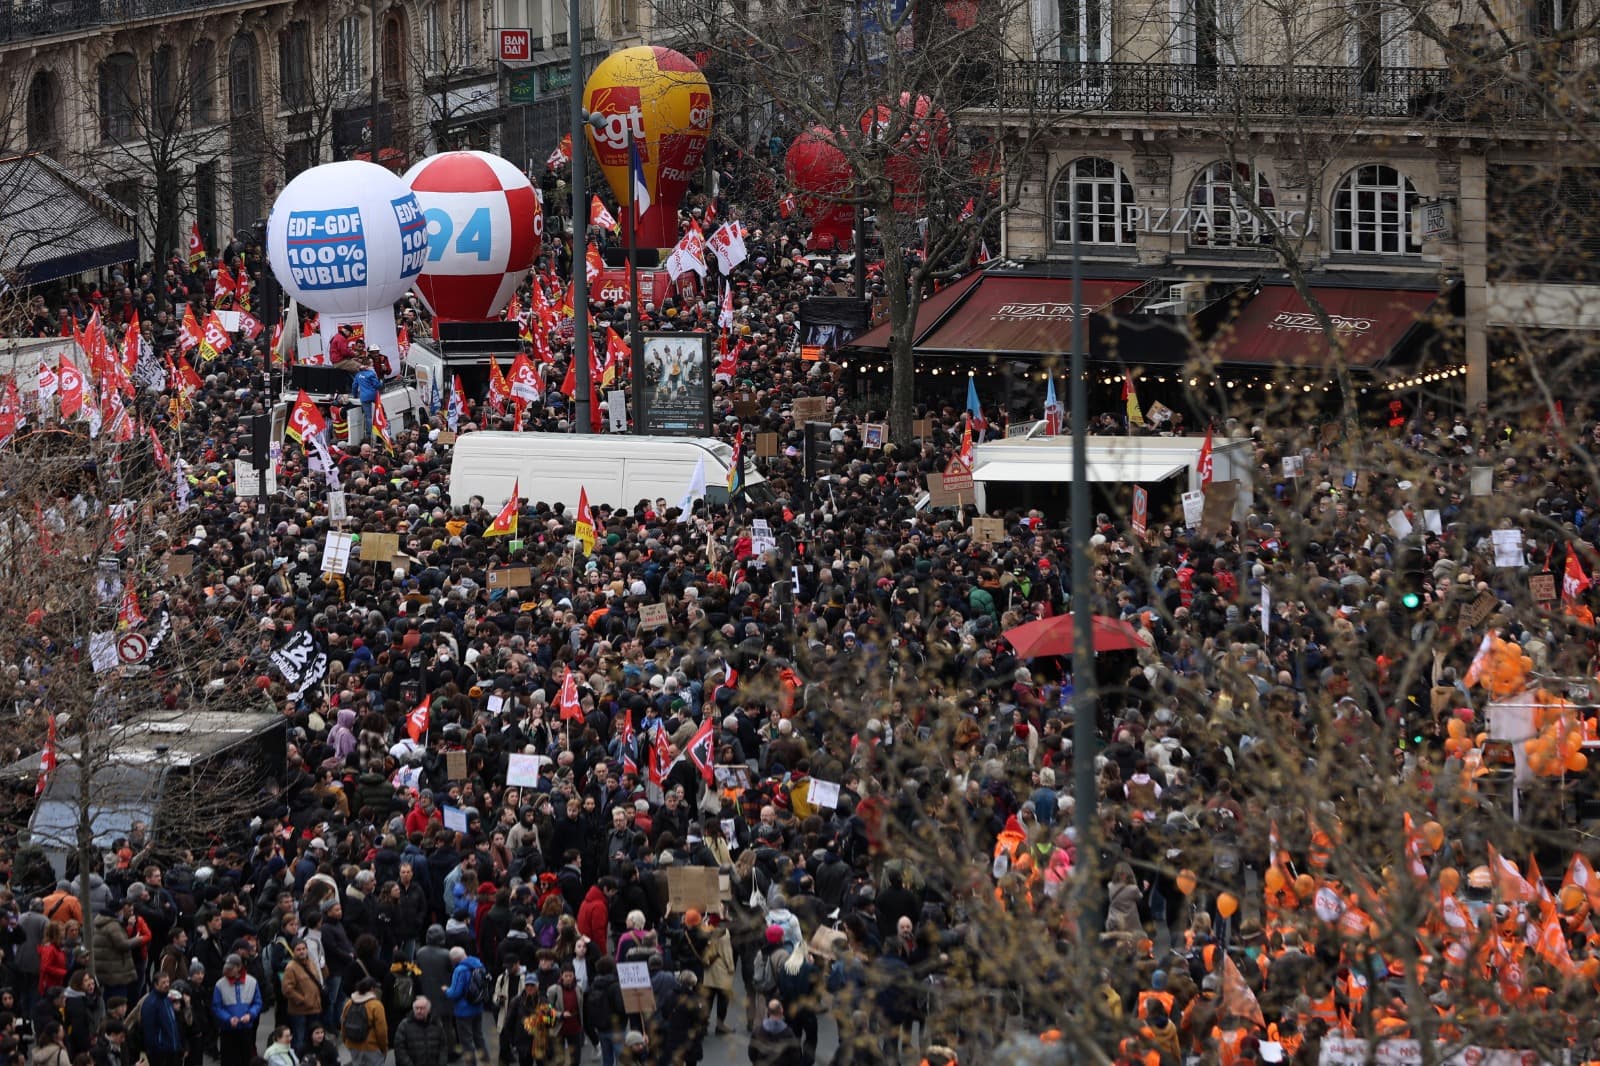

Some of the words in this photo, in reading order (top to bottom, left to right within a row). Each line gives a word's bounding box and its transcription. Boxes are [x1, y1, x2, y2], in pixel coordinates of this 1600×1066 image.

[504, 36, 525, 45] BAN
[504, 46, 521, 54] DAI
[690, 106, 712, 128] cgt
[592, 106, 646, 149] cgt
[288, 213, 361, 237] EDF-GDF
[1127, 207, 1215, 233] PIZZA
[427, 207, 491, 262] 94
[288, 246, 364, 265] 100%
[293, 262, 366, 286] PUBLIC
[600, 286, 624, 300] cgt
[998, 305, 1046, 315] PIZZA
[1331, 318, 1371, 331] PINO
